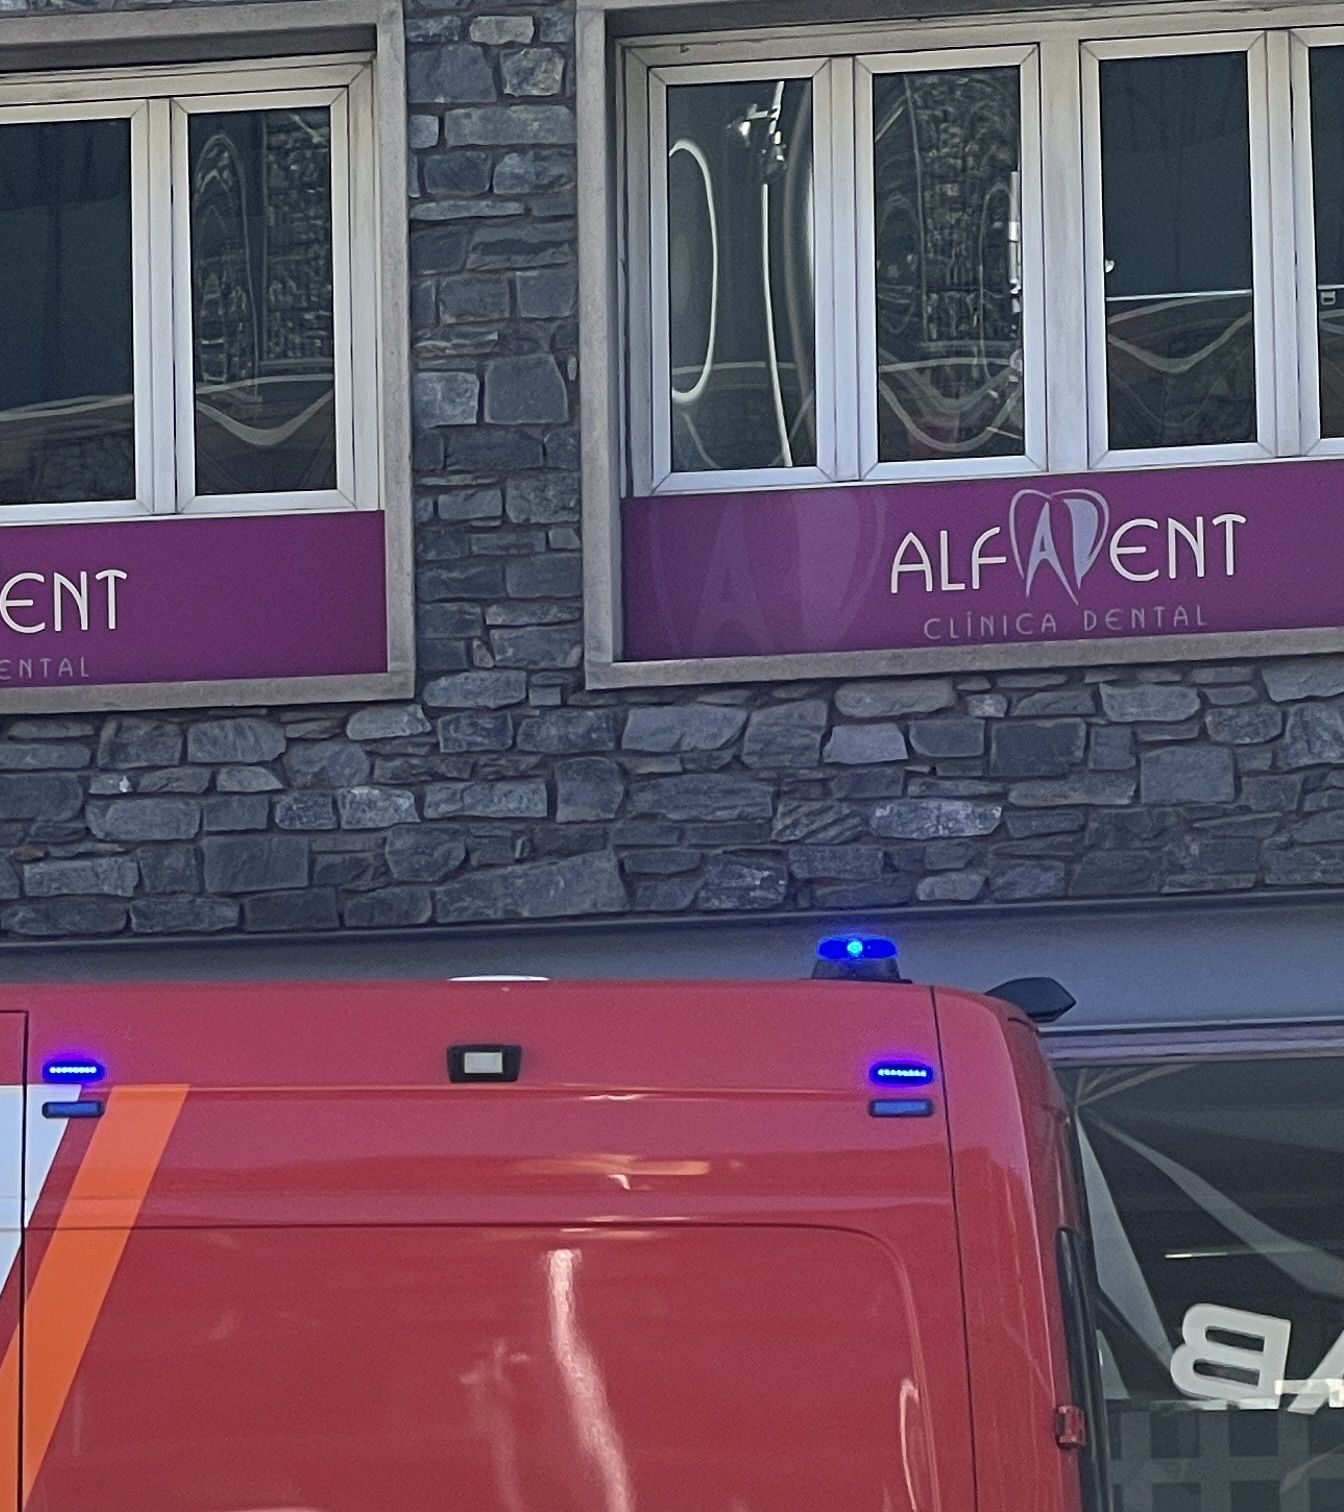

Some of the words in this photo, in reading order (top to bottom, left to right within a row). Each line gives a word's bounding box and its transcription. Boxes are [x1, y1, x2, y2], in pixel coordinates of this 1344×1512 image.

[890, 496, 1248, 604] ALFADENT
[923, 611, 1057, 640] CLÍNICA
[1083, 605, 1209, 633] DENTAL
